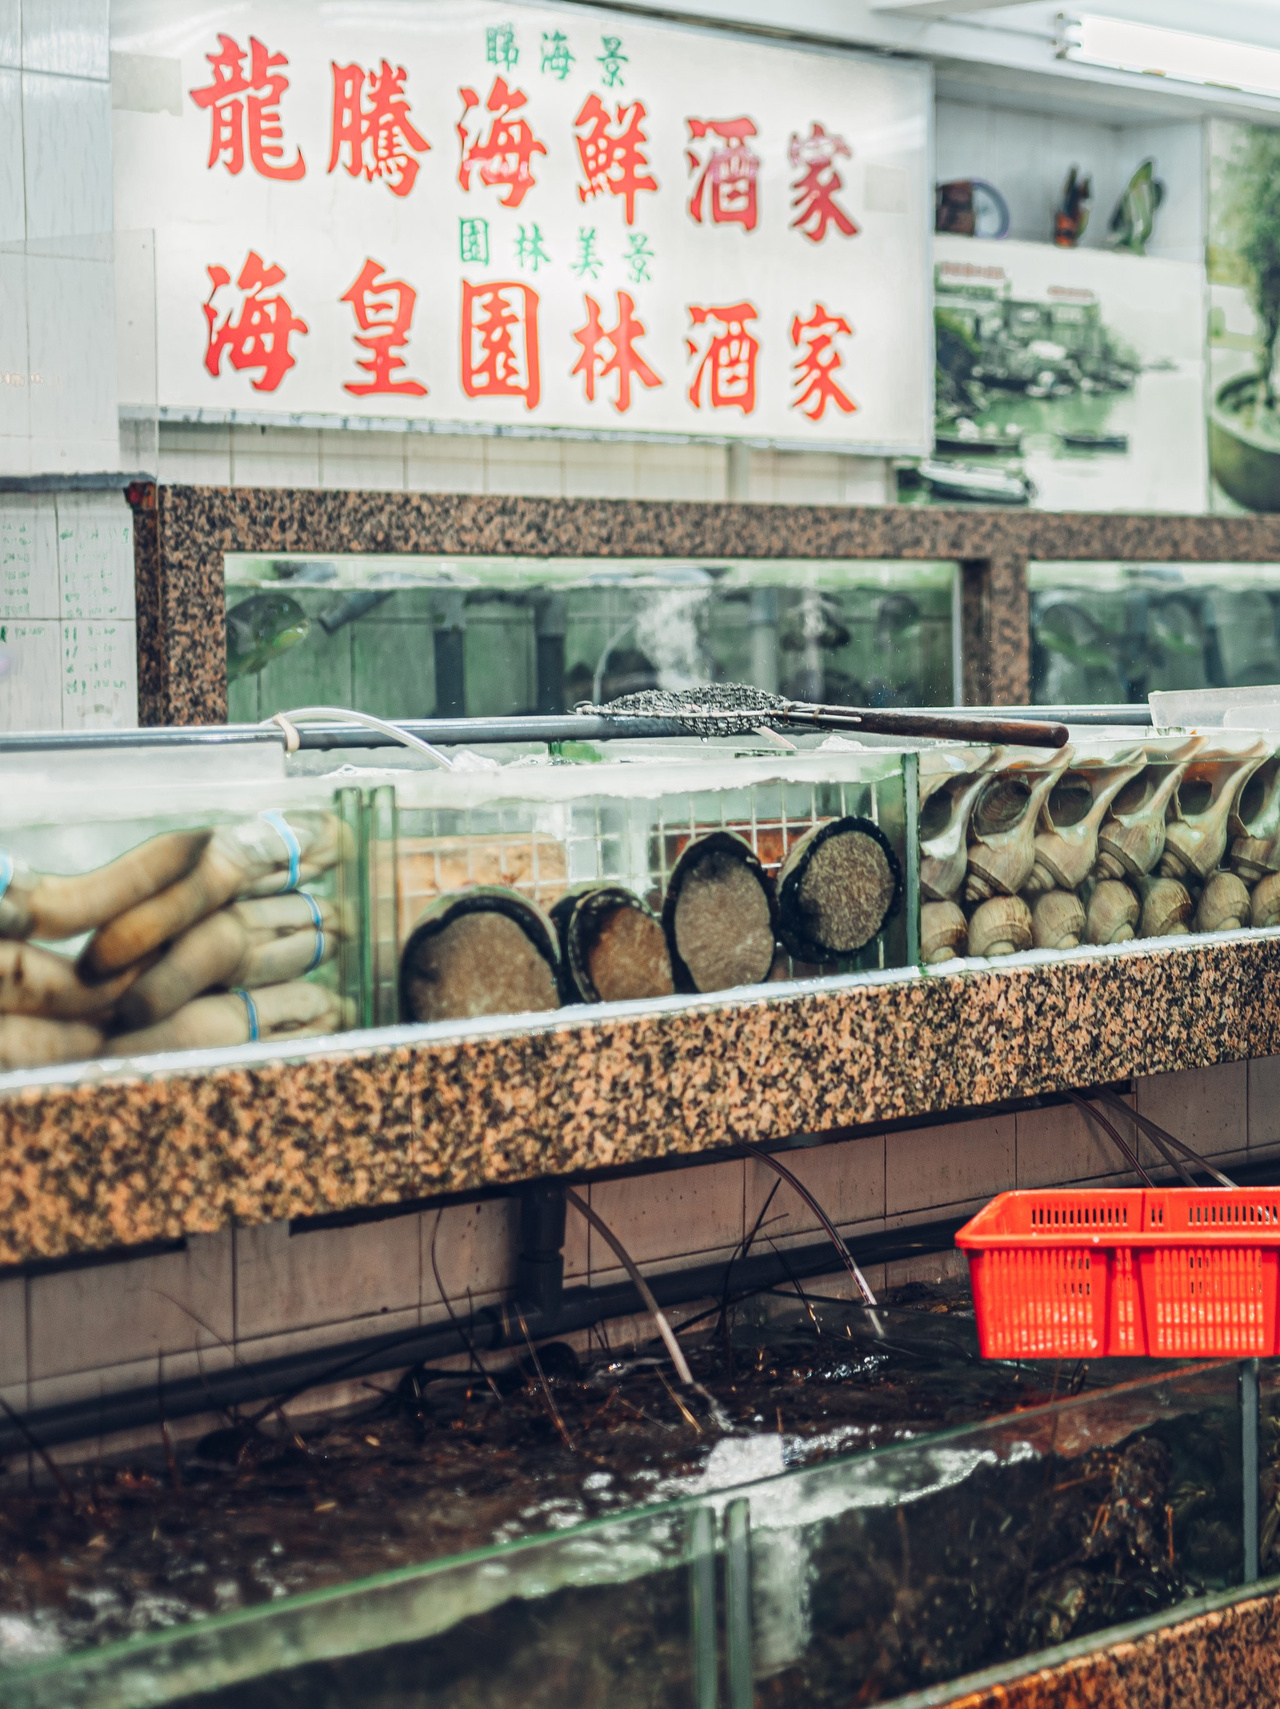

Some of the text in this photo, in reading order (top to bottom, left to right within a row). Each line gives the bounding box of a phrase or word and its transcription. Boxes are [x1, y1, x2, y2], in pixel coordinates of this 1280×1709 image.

[190, 33, 859, 243] 龍騰海鮮酒家
[203, 250, 858, 421] 海皇園林酒家
[458, 217, 655, 284] 園林美景
